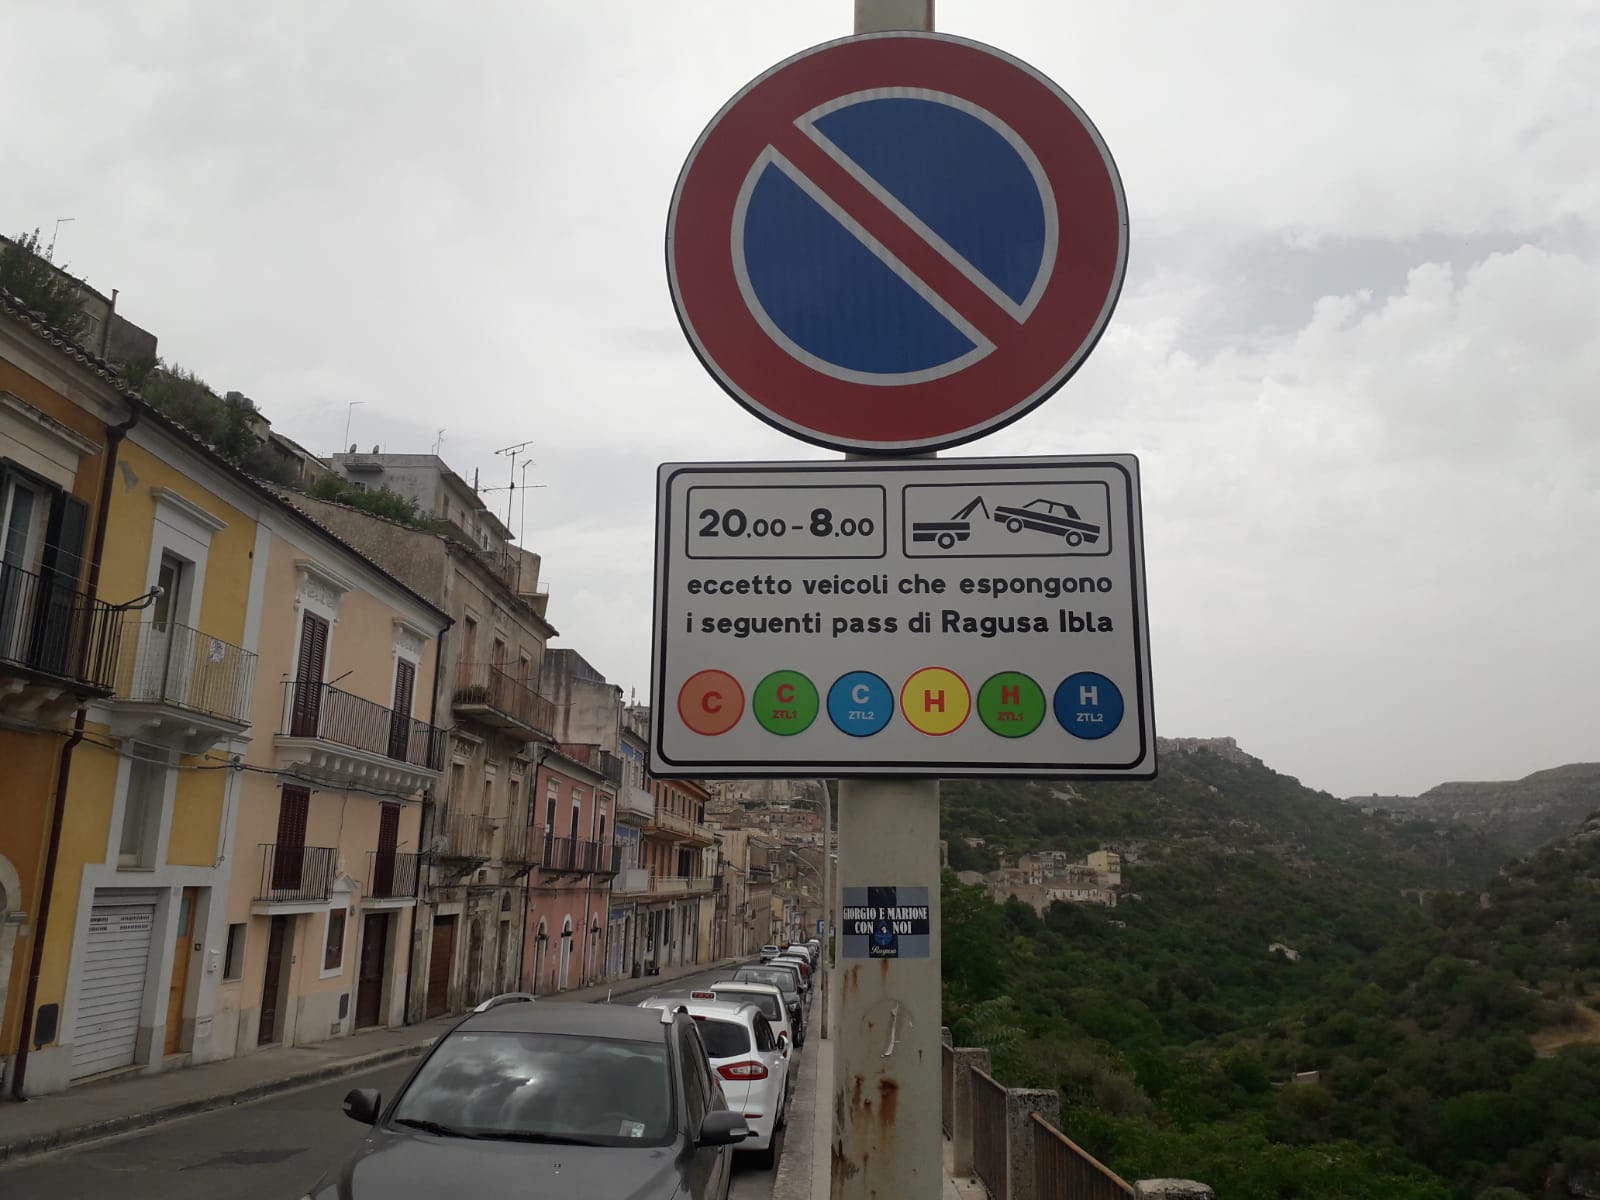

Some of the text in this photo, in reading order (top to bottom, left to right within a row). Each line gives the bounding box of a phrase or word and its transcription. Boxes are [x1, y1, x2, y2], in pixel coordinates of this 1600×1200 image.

[687, 573, 1113, 599] eccetto veicoli che espongono
[686, 608, 1114, 639] i seguenti pass di Ragusa Ibla
[701, 691, 722, 714] C
[776, 683, 795, 704] C
[851, 684, 870, 704] C
[924, 689, 945, 713] H
[1001, 685, 1020, 705] H
[1079, 685, 1098, 705] H
[772, 709, 798, 720] ZTL1
[848, 710, 874, 720] ZTL2
[997, 711, 1024, 721] ZTL1
[1076, 712, 1103, 722] ZTL2
[843, 907, 928, 920] GIORGIO E MARIONE
[855, 921, 912, 934] CON NOI
